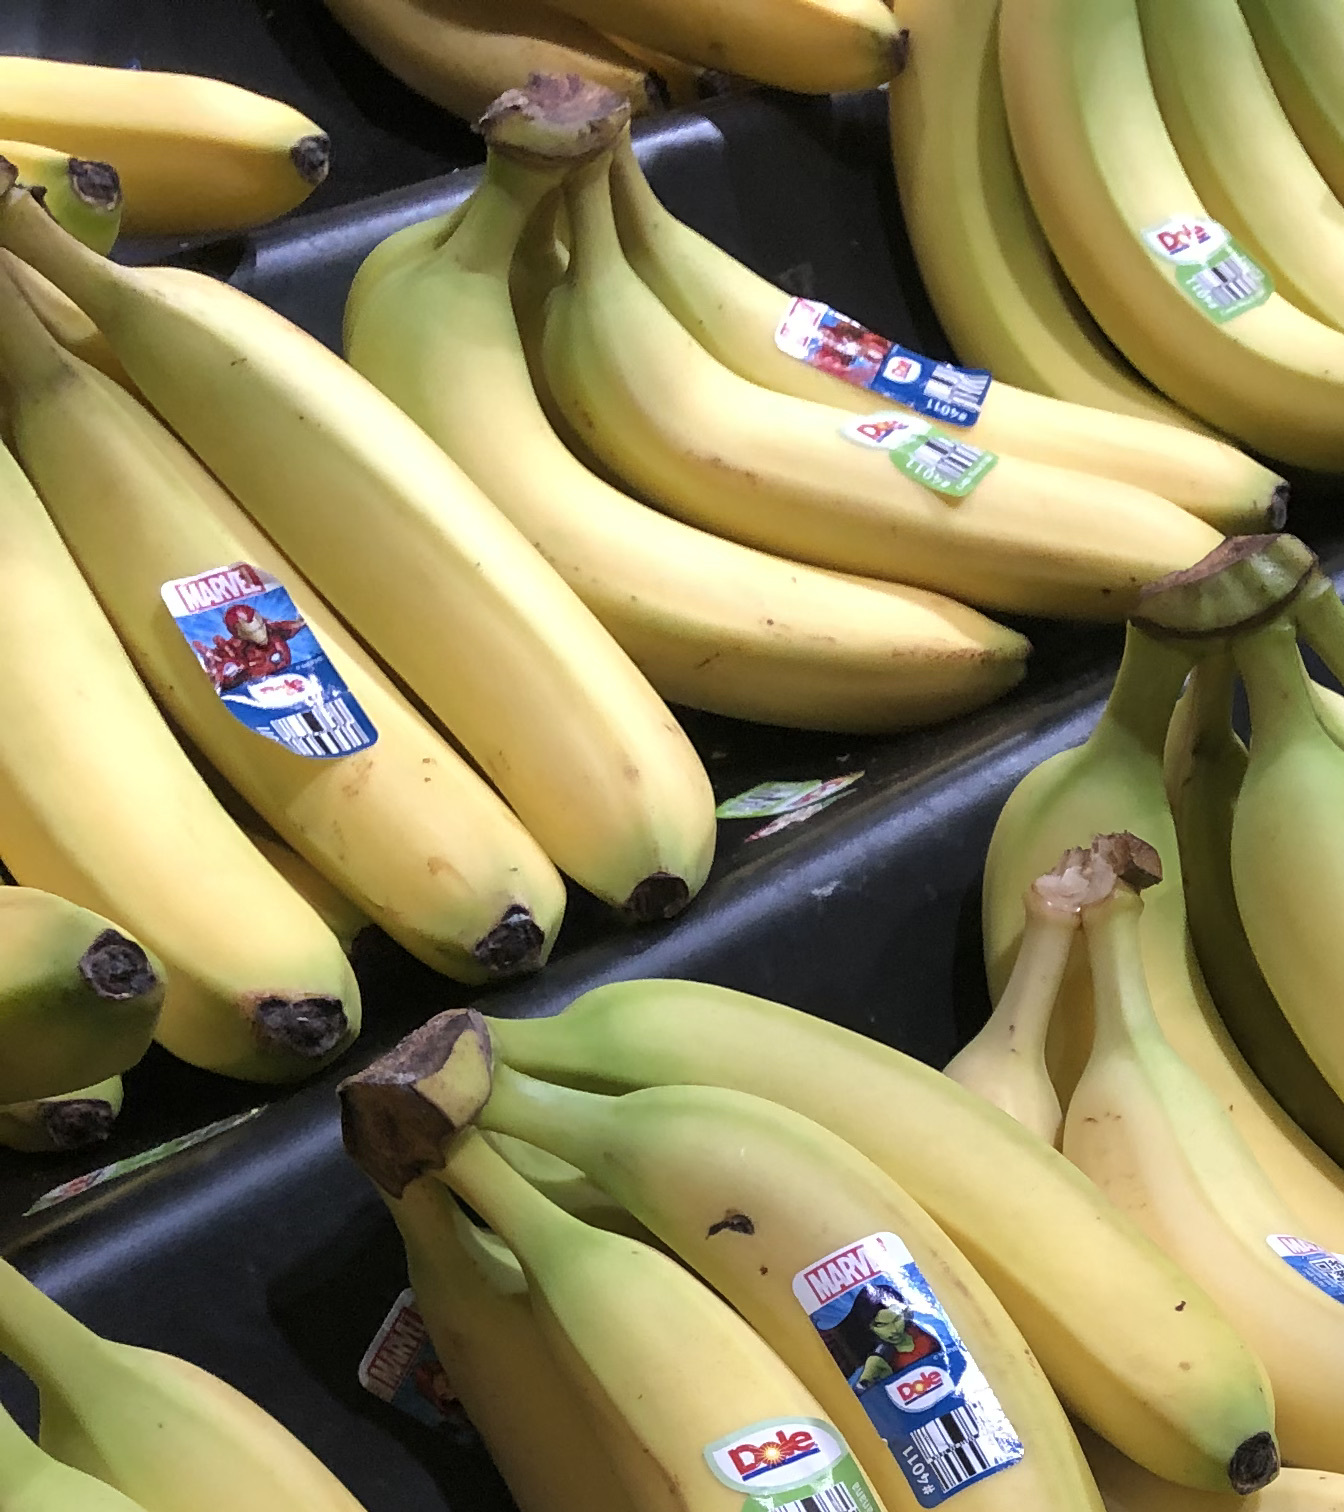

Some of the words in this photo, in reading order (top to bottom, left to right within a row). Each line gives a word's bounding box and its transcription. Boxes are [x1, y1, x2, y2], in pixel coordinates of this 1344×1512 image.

[896, 1370, 941, 1402] Dole
[728, 1430, 816, 1476] Dole
[902, 1444, 935, 1495] #4011
